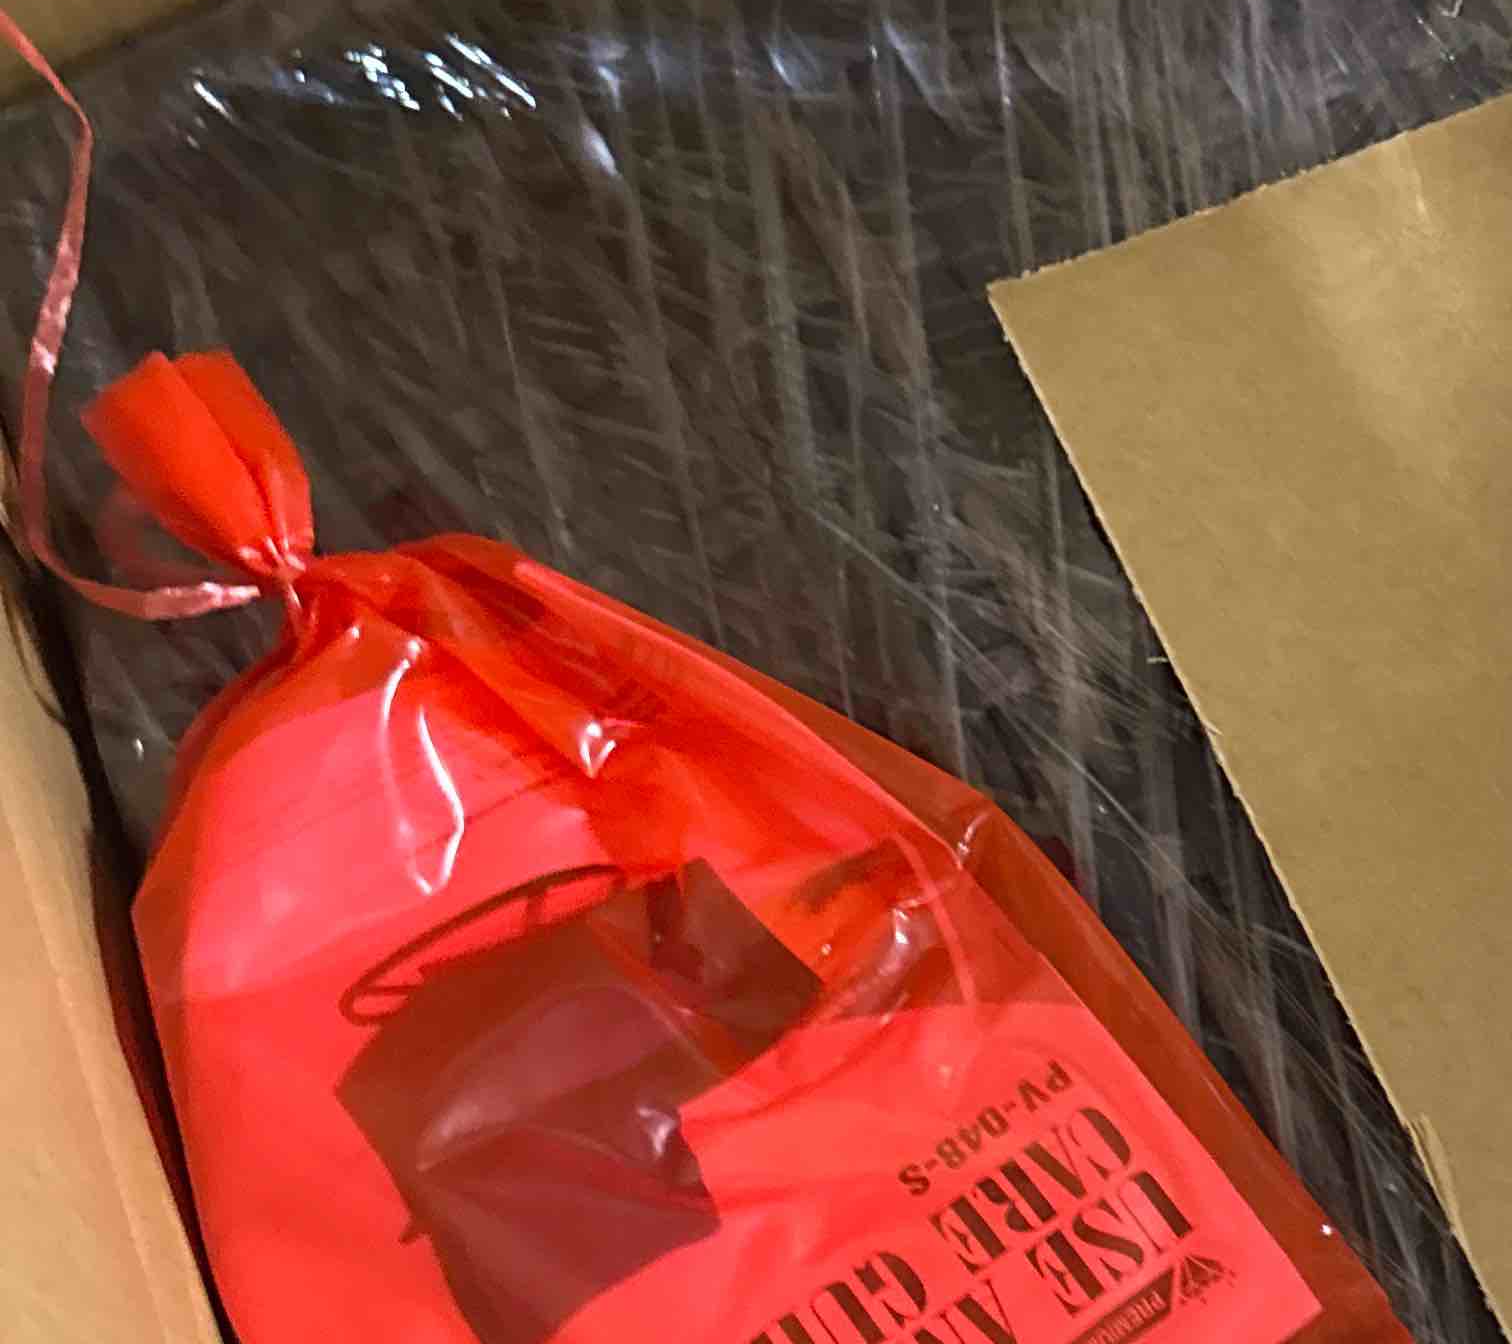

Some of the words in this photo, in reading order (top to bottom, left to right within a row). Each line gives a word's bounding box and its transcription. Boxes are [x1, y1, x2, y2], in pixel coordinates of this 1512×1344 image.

[899, 1059, 1074, 1197] PV-048-S
[928, 1106, 1131, 1276] CARE
[1025, 1170, 1194, 1316] USE
